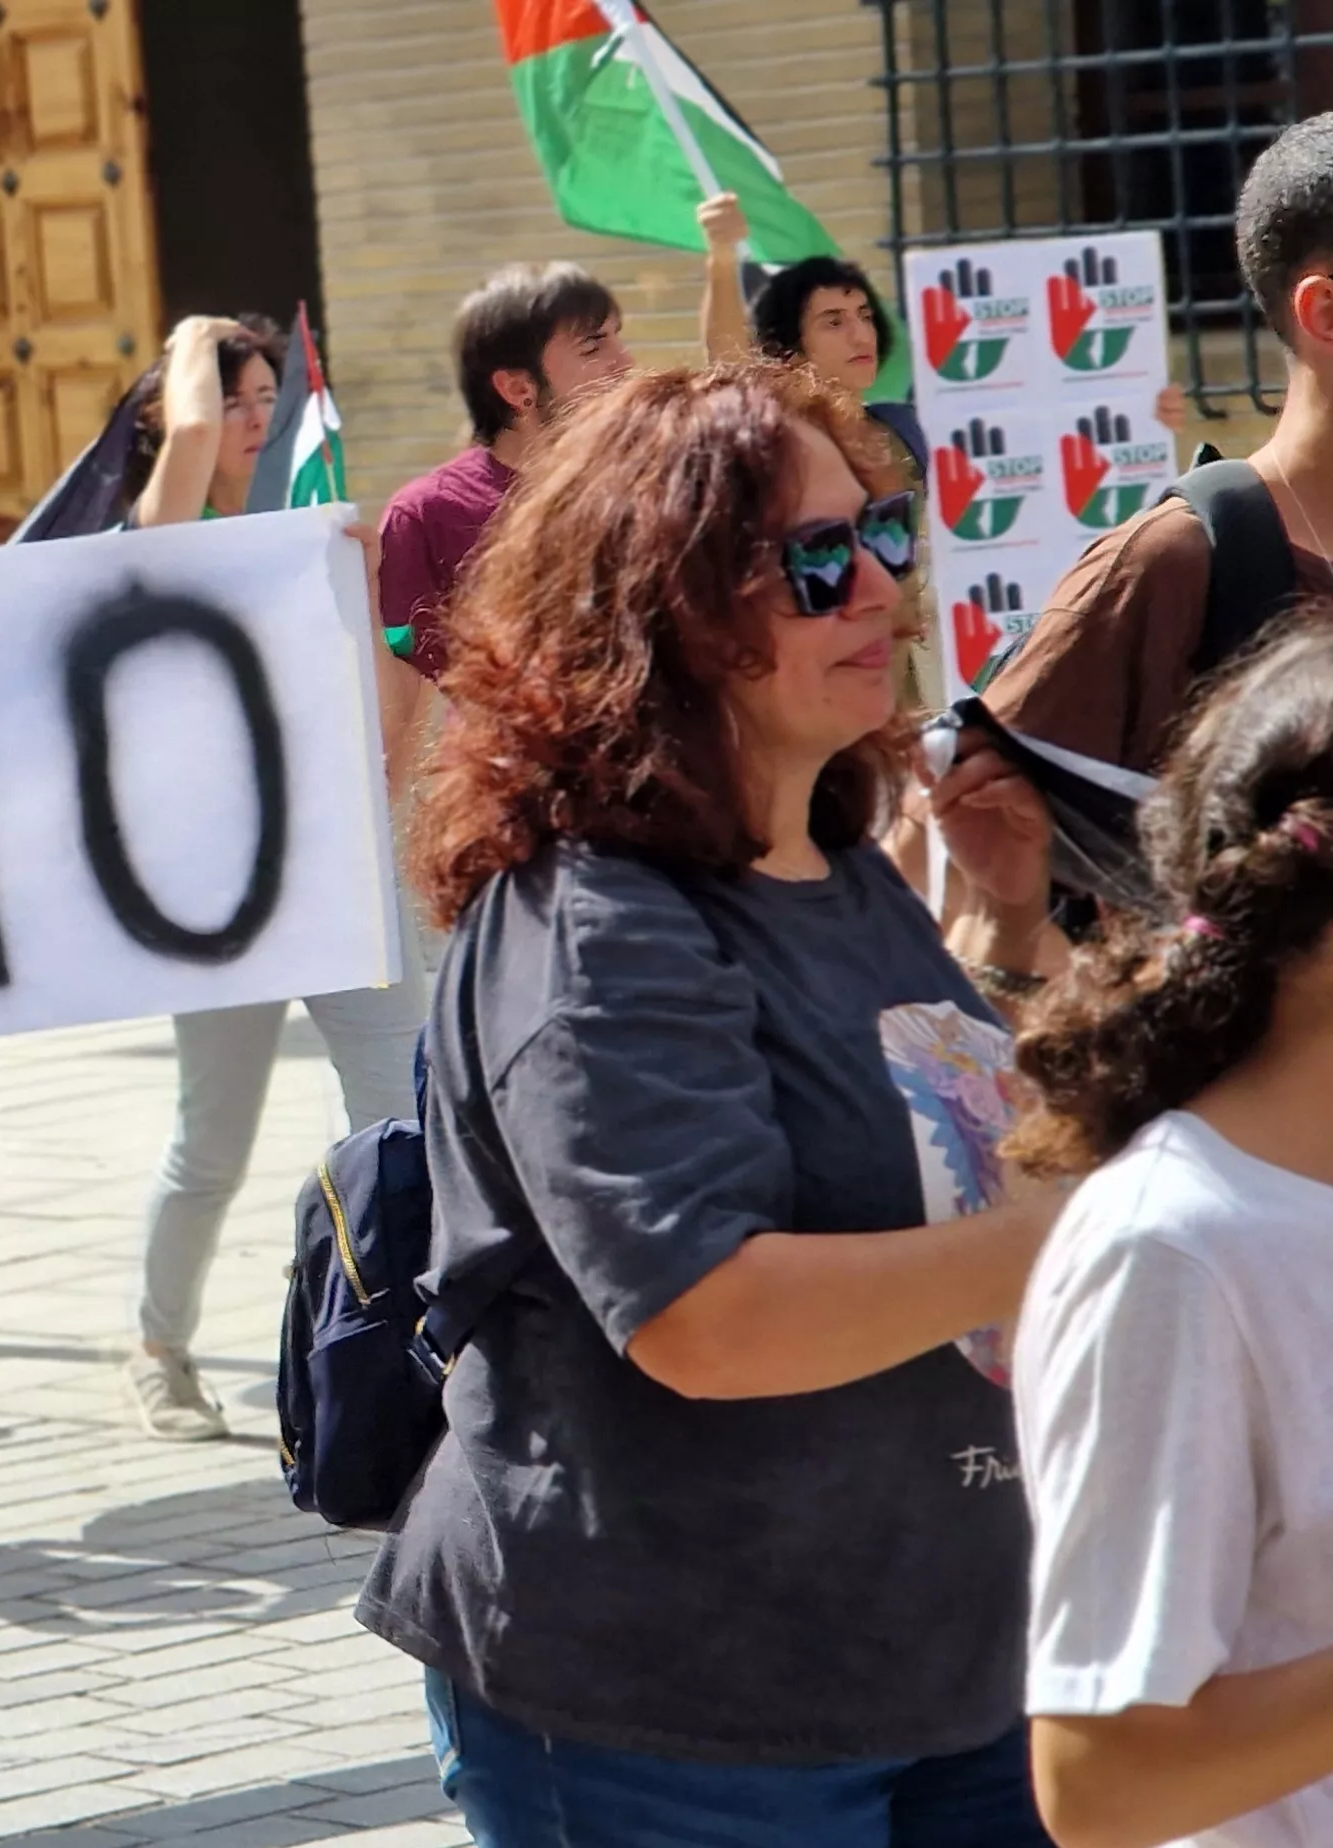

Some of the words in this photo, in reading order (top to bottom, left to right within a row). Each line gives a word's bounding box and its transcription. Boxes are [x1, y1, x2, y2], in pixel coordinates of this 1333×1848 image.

[1098, 285, 1154, 308] STOP
[974, 297, 1029, 320] STOP
[1112, 442, 1168, 465] STOP
[986, 455, 1043, 478] STOP
[950, 1444, 1022, 1489] Fri
